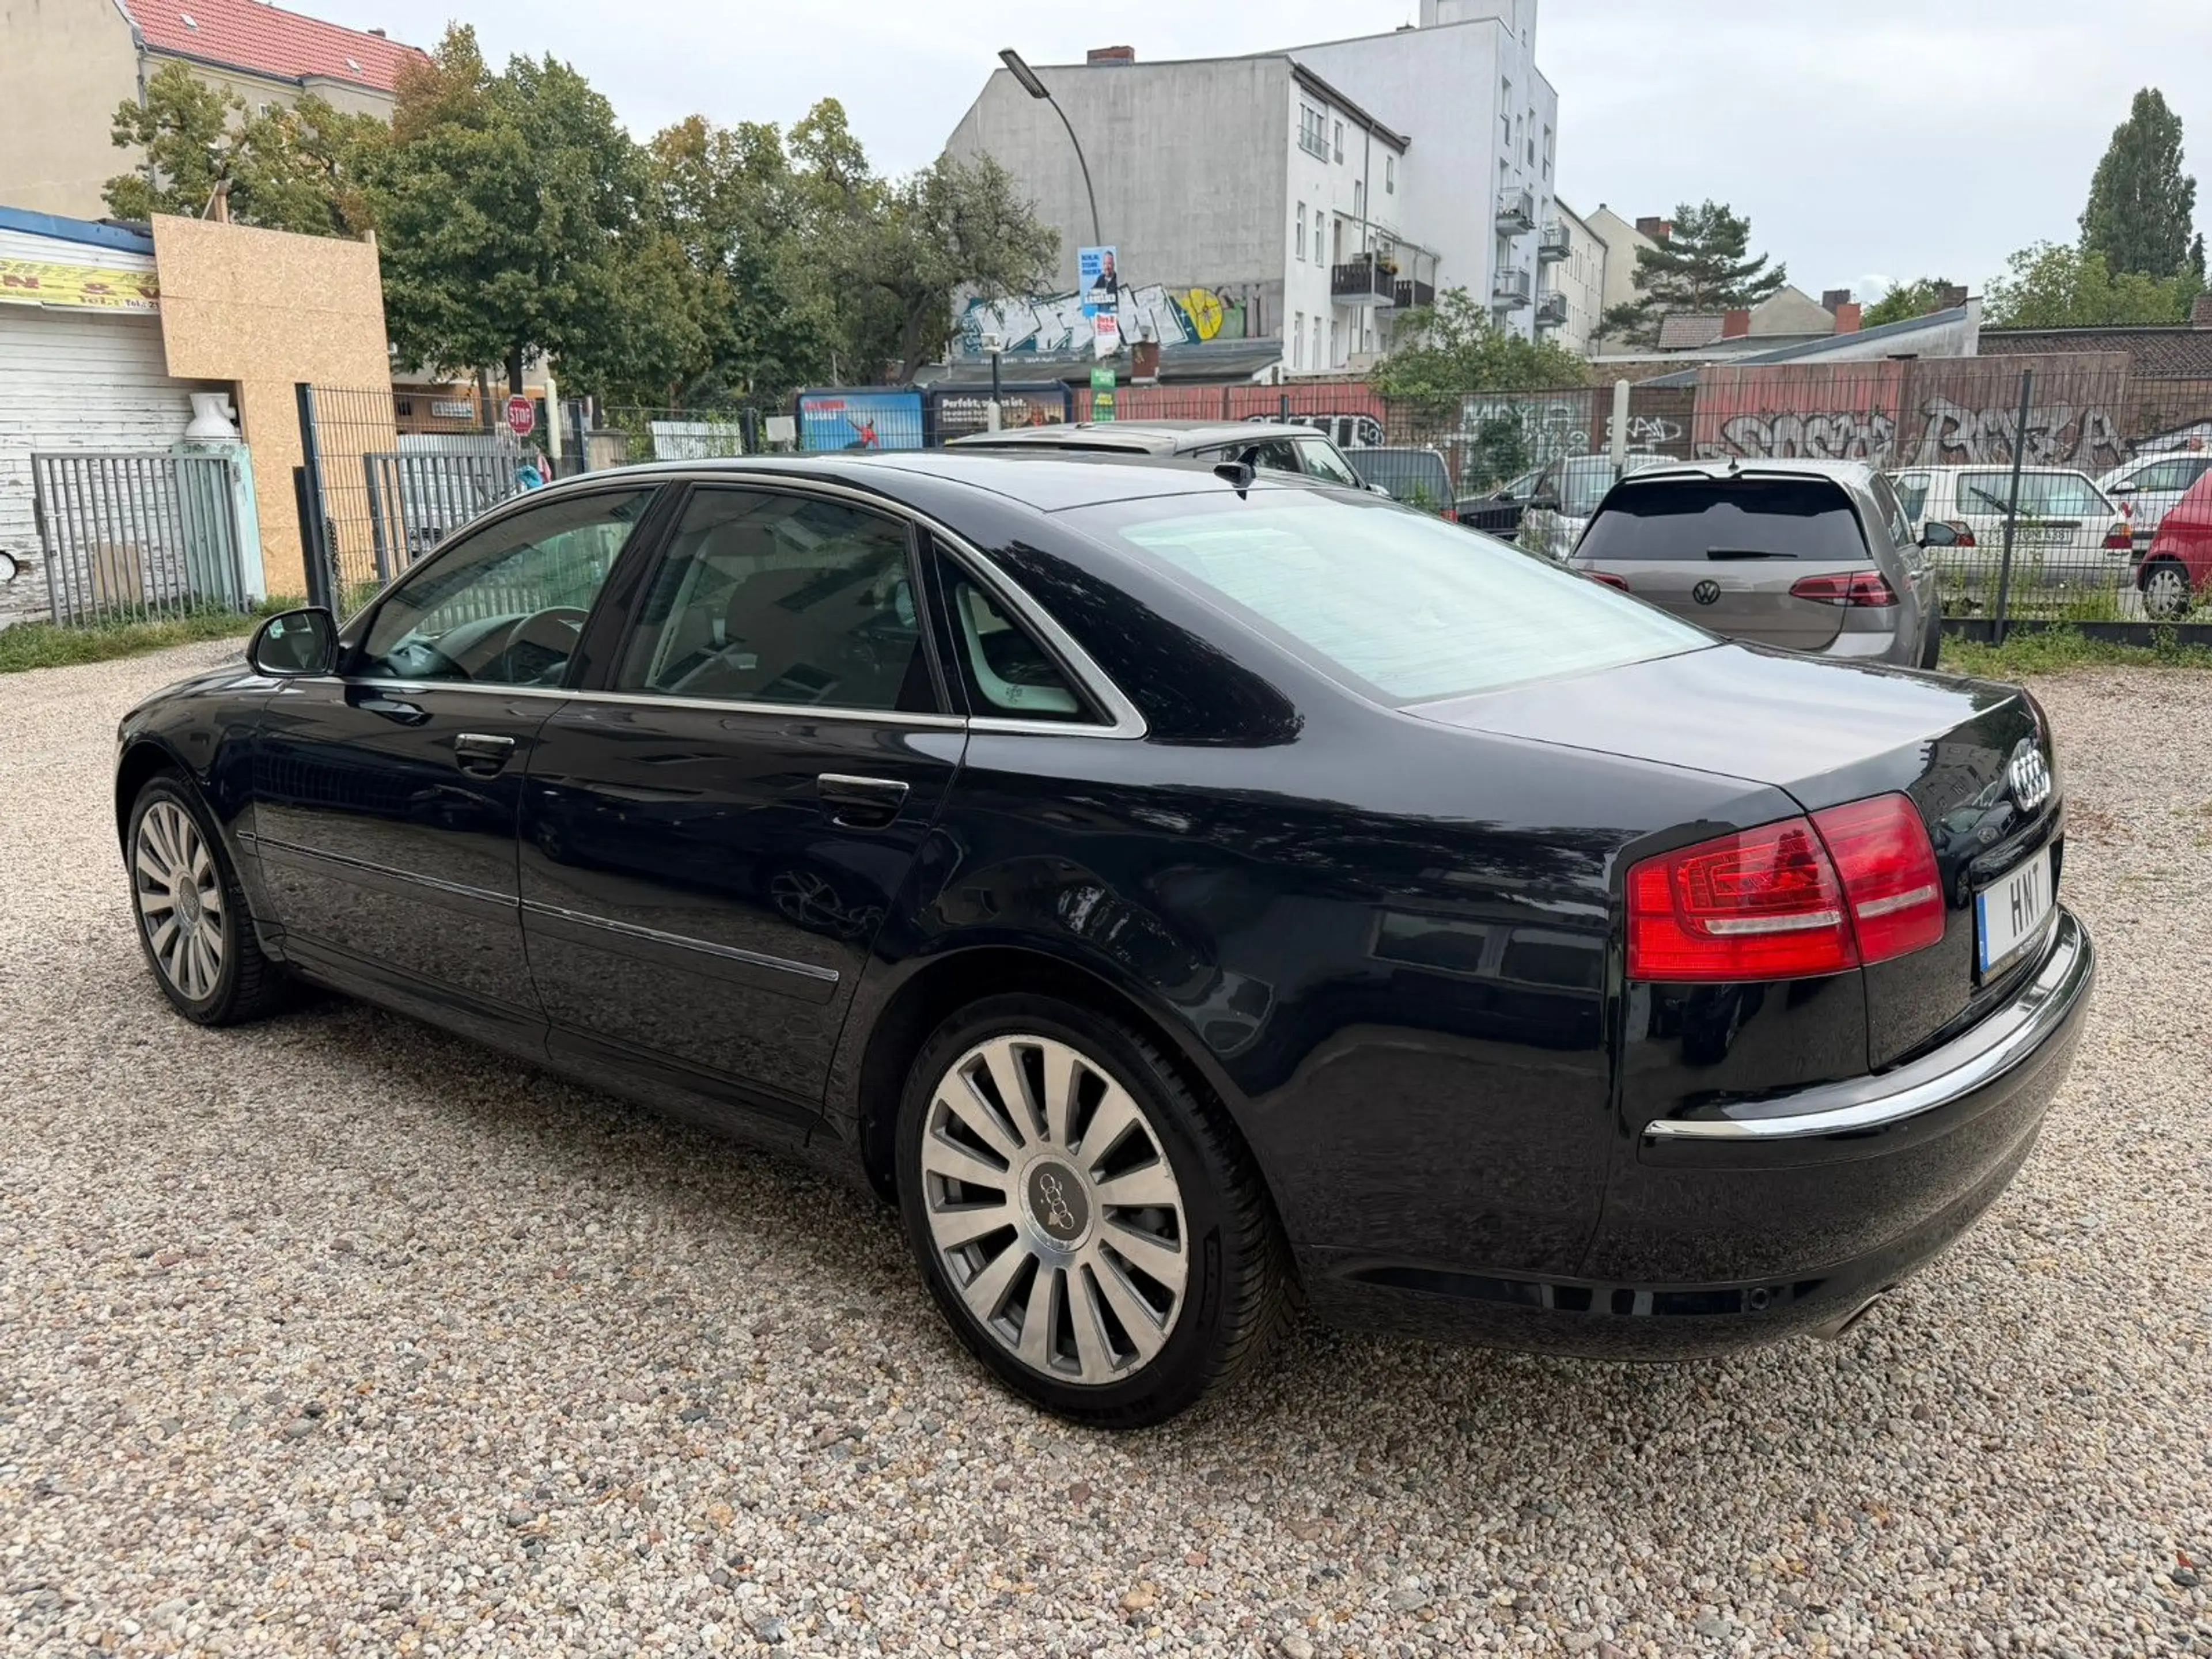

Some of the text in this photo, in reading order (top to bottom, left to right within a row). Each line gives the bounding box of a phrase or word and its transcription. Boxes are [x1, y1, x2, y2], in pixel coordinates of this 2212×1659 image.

[942, 397, 980, 408] Perfekt,
[509, 406, 531, 425] STOP
[2010, 862, 2040, 938] HNT
